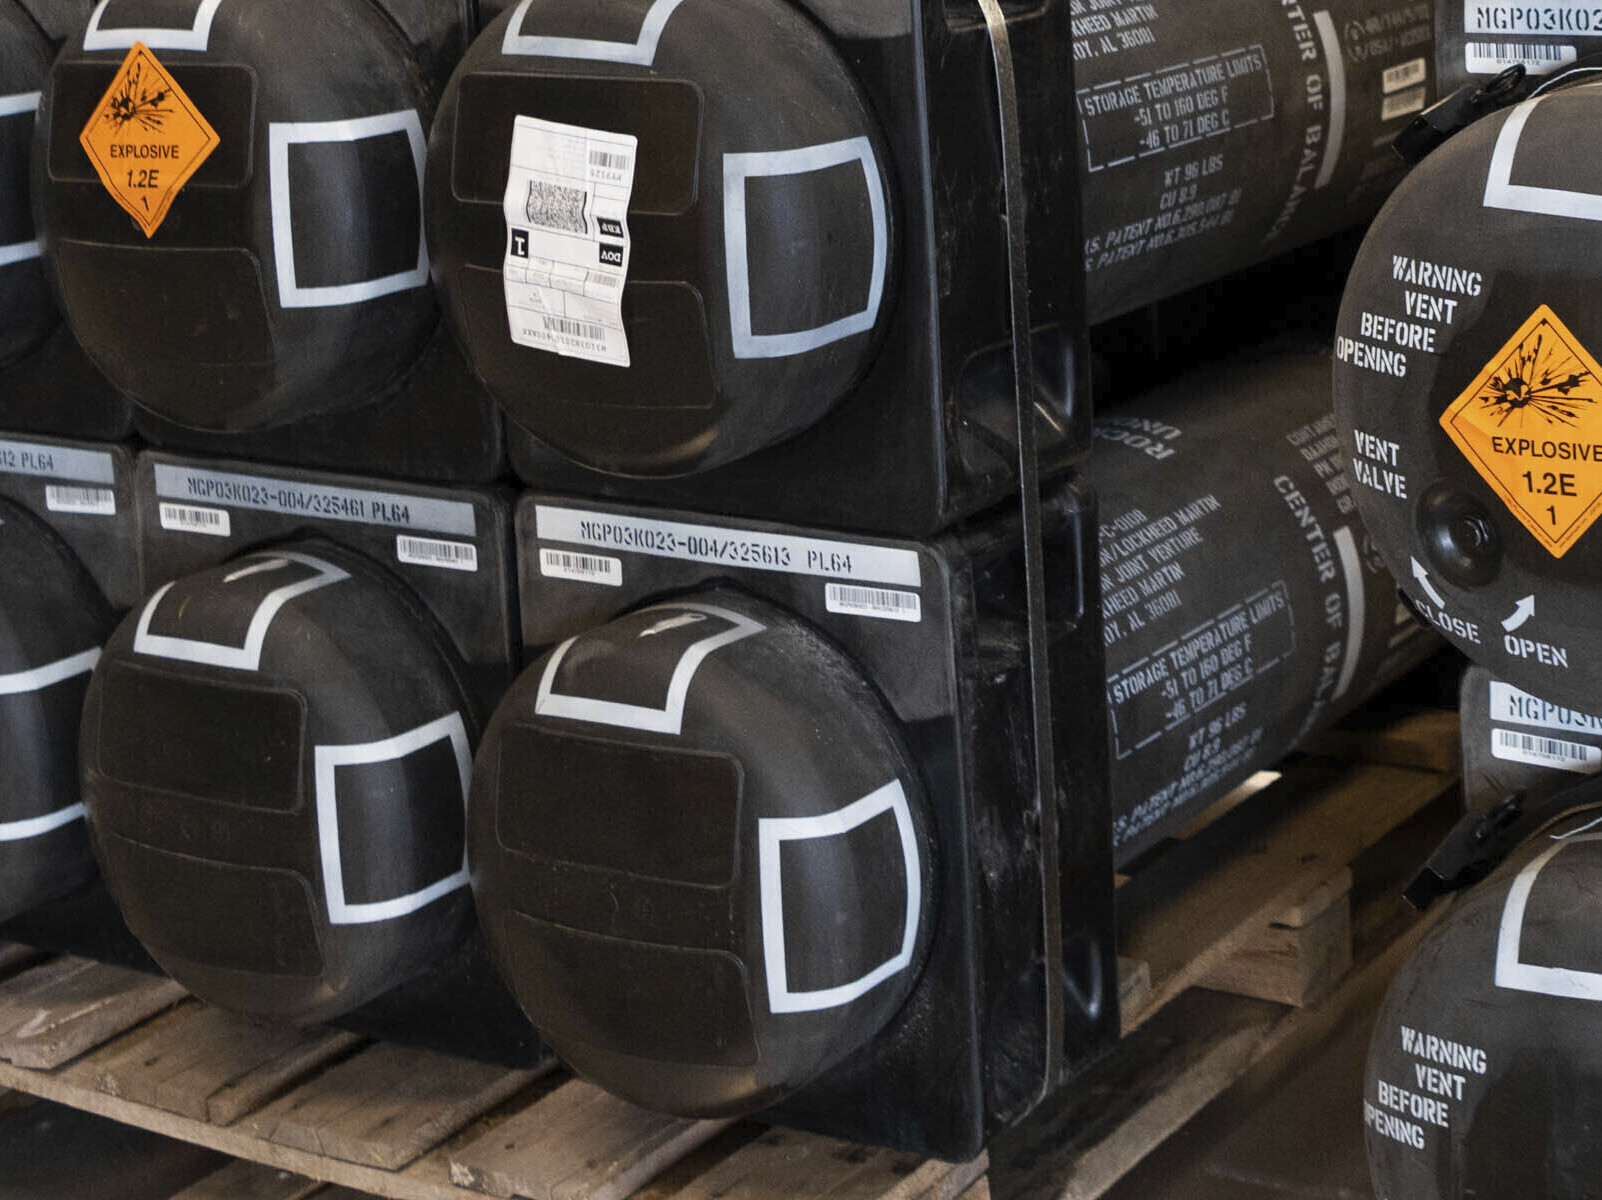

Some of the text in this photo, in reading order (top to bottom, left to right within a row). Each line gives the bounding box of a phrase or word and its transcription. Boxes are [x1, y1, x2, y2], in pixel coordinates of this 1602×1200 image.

[1111, 3, 1159, 28] MARTIN
[1084, 54, 1262, 117] STORAGE TEMPERATURE LIMITS
[1155, 103, 1171, 120] TO
[1198, 89, 1219, 110] DEG
[1222, 86, 1228, 103] F
[1306, 74, 1323, 112] OF
[1165, 124, 1179, 144] TO
[1197, 114, 1219, 133] DEG
[110, 144, 179, 159] EXPLOSIVE
[127, 170, 159, 188] 1.2E
[1392, 254, 1483, 297] WARNING
[1404, 291, 1458, 325] VENT
[1360, 312, 1436, 353] BEFORE
[1337, 335, 1407, 378] OPENING
[21, 451, 54, 473] PL64
[1353, 429, 1400, 467] VENT
[1352, 457, 1408, 500] VALVE
[1522, 470, 1578, 498] 1.2E
[372, 502, 410, 524] PL64
[1274, 474, 1336, 584] CENTER
[1546, 504, 1557, 526] 1
[807, 550, 853, 574] PL64
[1137, 561, 1186, 597] MARTIN
[1113, 590, 1286, 704] STORAGE TEMPERATURE LIMITS
[1415, 599, 1568, 668] CLOSE OPEN
[1181, 667, 1197, 689] TO
[1189, 687, 1204, 709] TO
[1401, 1025, 1487, 1074] WARNING
[1415, 1063, 1466, 1100] VENT
[1378, 1080, 1449, 1128] BEFORE
